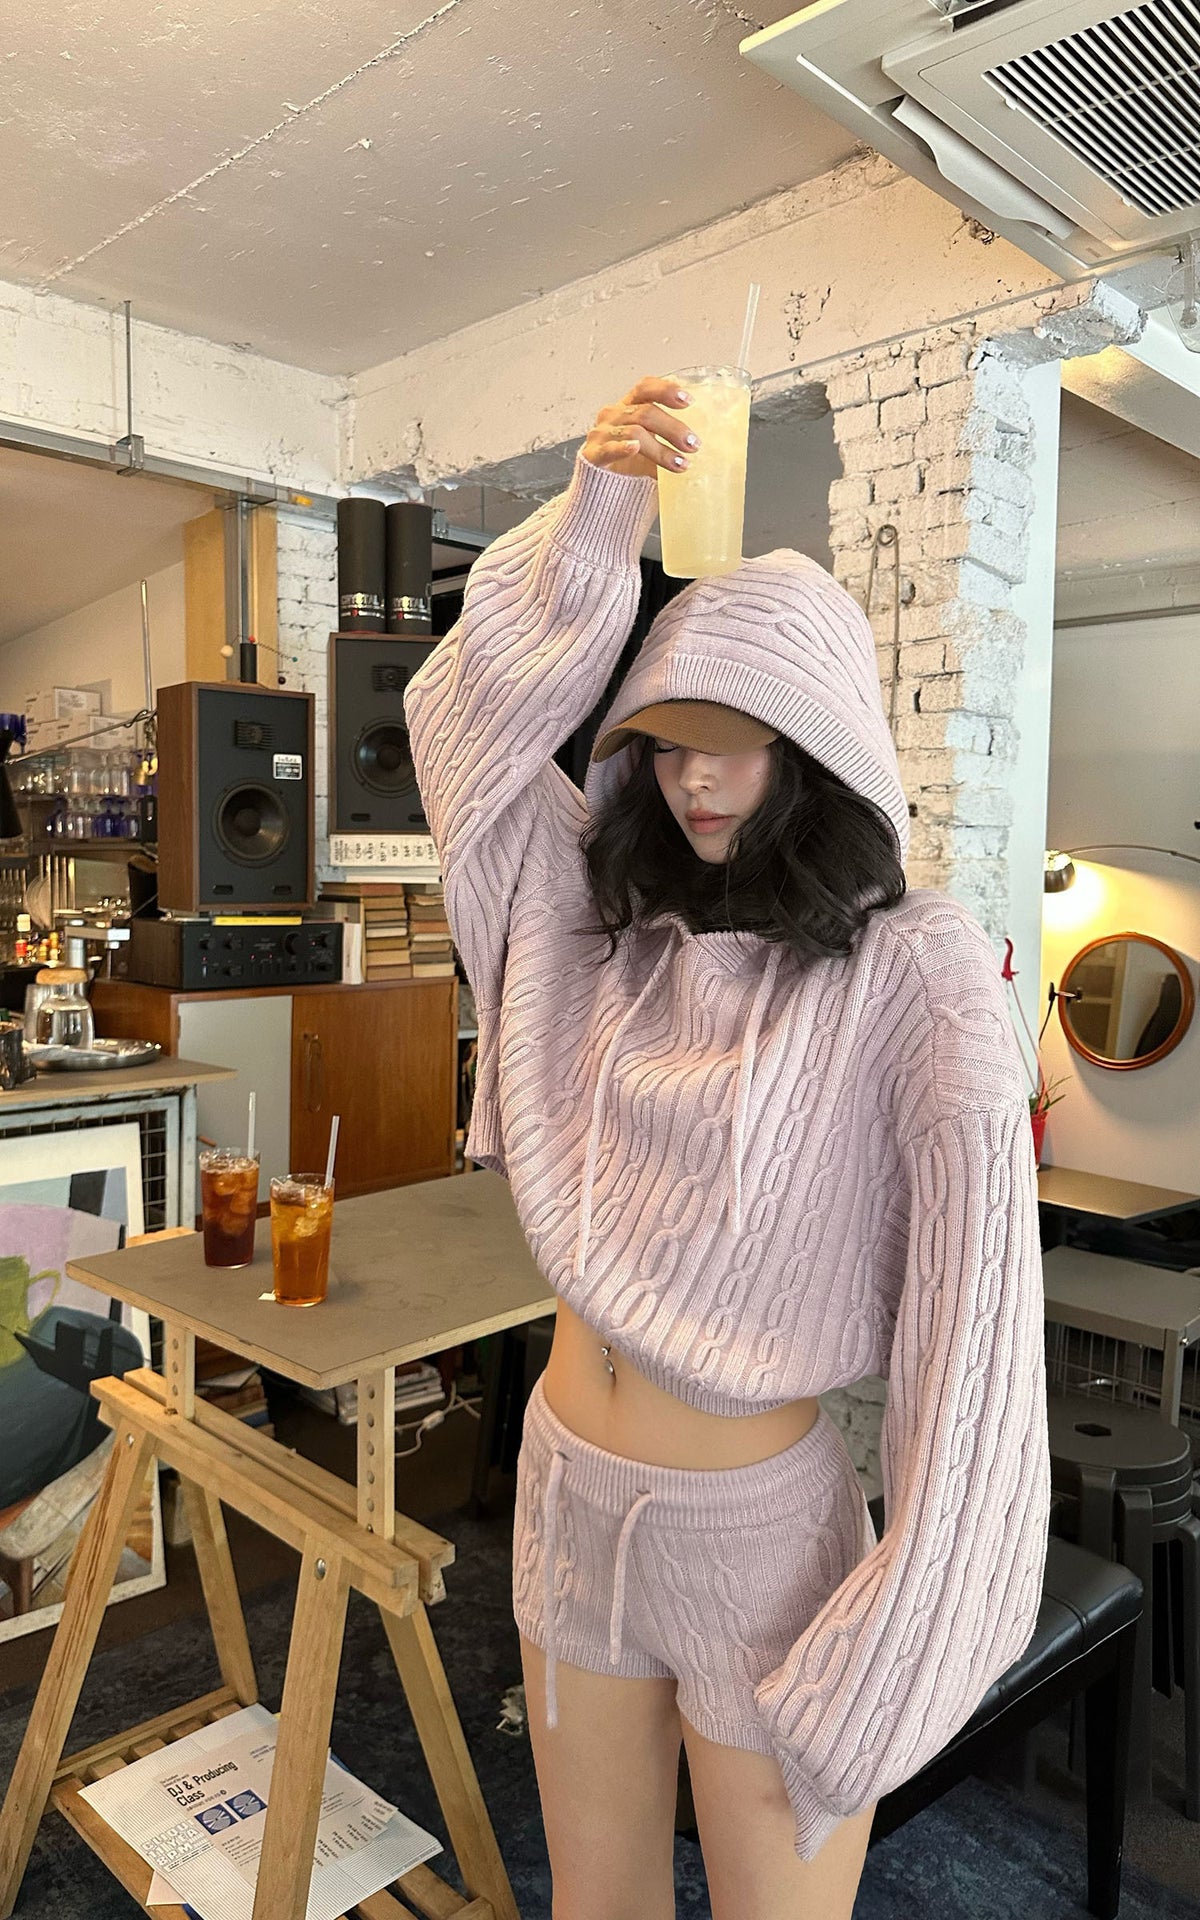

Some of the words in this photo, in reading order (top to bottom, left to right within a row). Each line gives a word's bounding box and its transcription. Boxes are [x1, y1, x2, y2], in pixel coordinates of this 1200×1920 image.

[167, 1784, 184, 1798] DJ
[182, 1780, 194, 1790] &
[192, 1761, 238, 1785] Producing
[176, 1789, 205, 1807] Class
